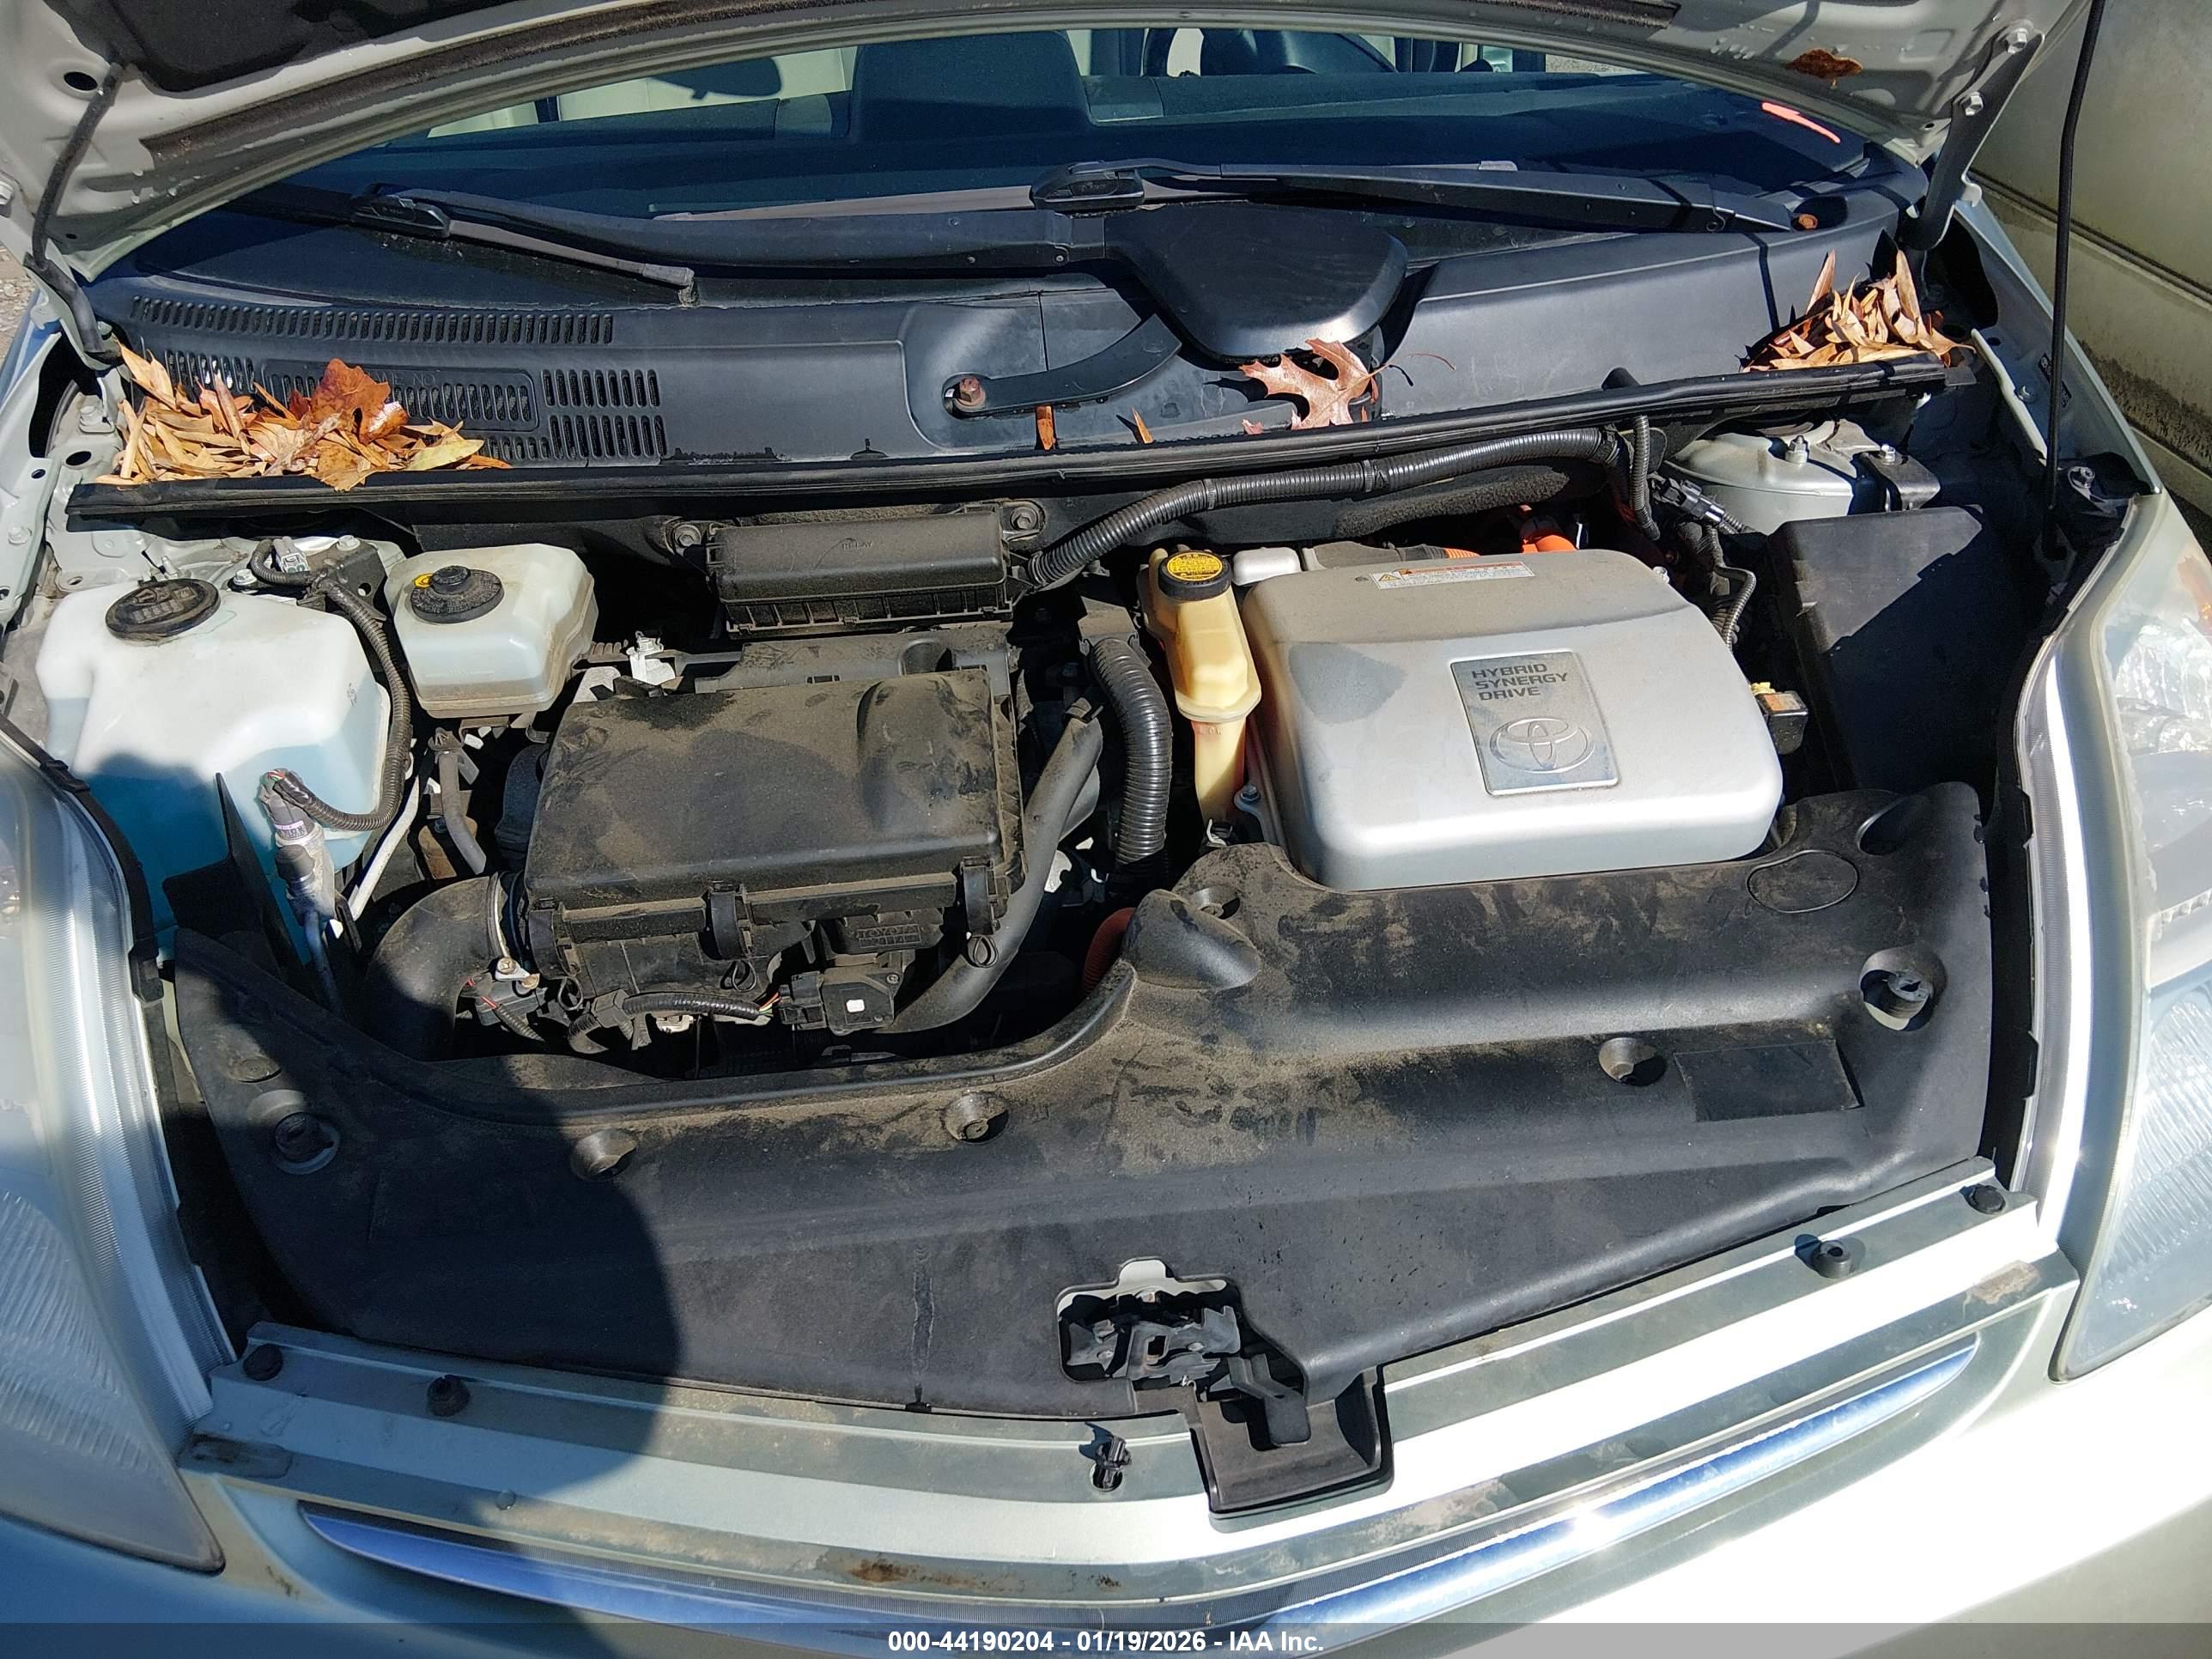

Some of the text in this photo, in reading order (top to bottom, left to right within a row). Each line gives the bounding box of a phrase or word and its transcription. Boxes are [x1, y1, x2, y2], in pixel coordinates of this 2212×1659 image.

[1471, 664, 1547, 678] HYBRID
[1475, 672, 1567, 690] SYNERGY
[1479, 686, 1540, 701] DRIVE
